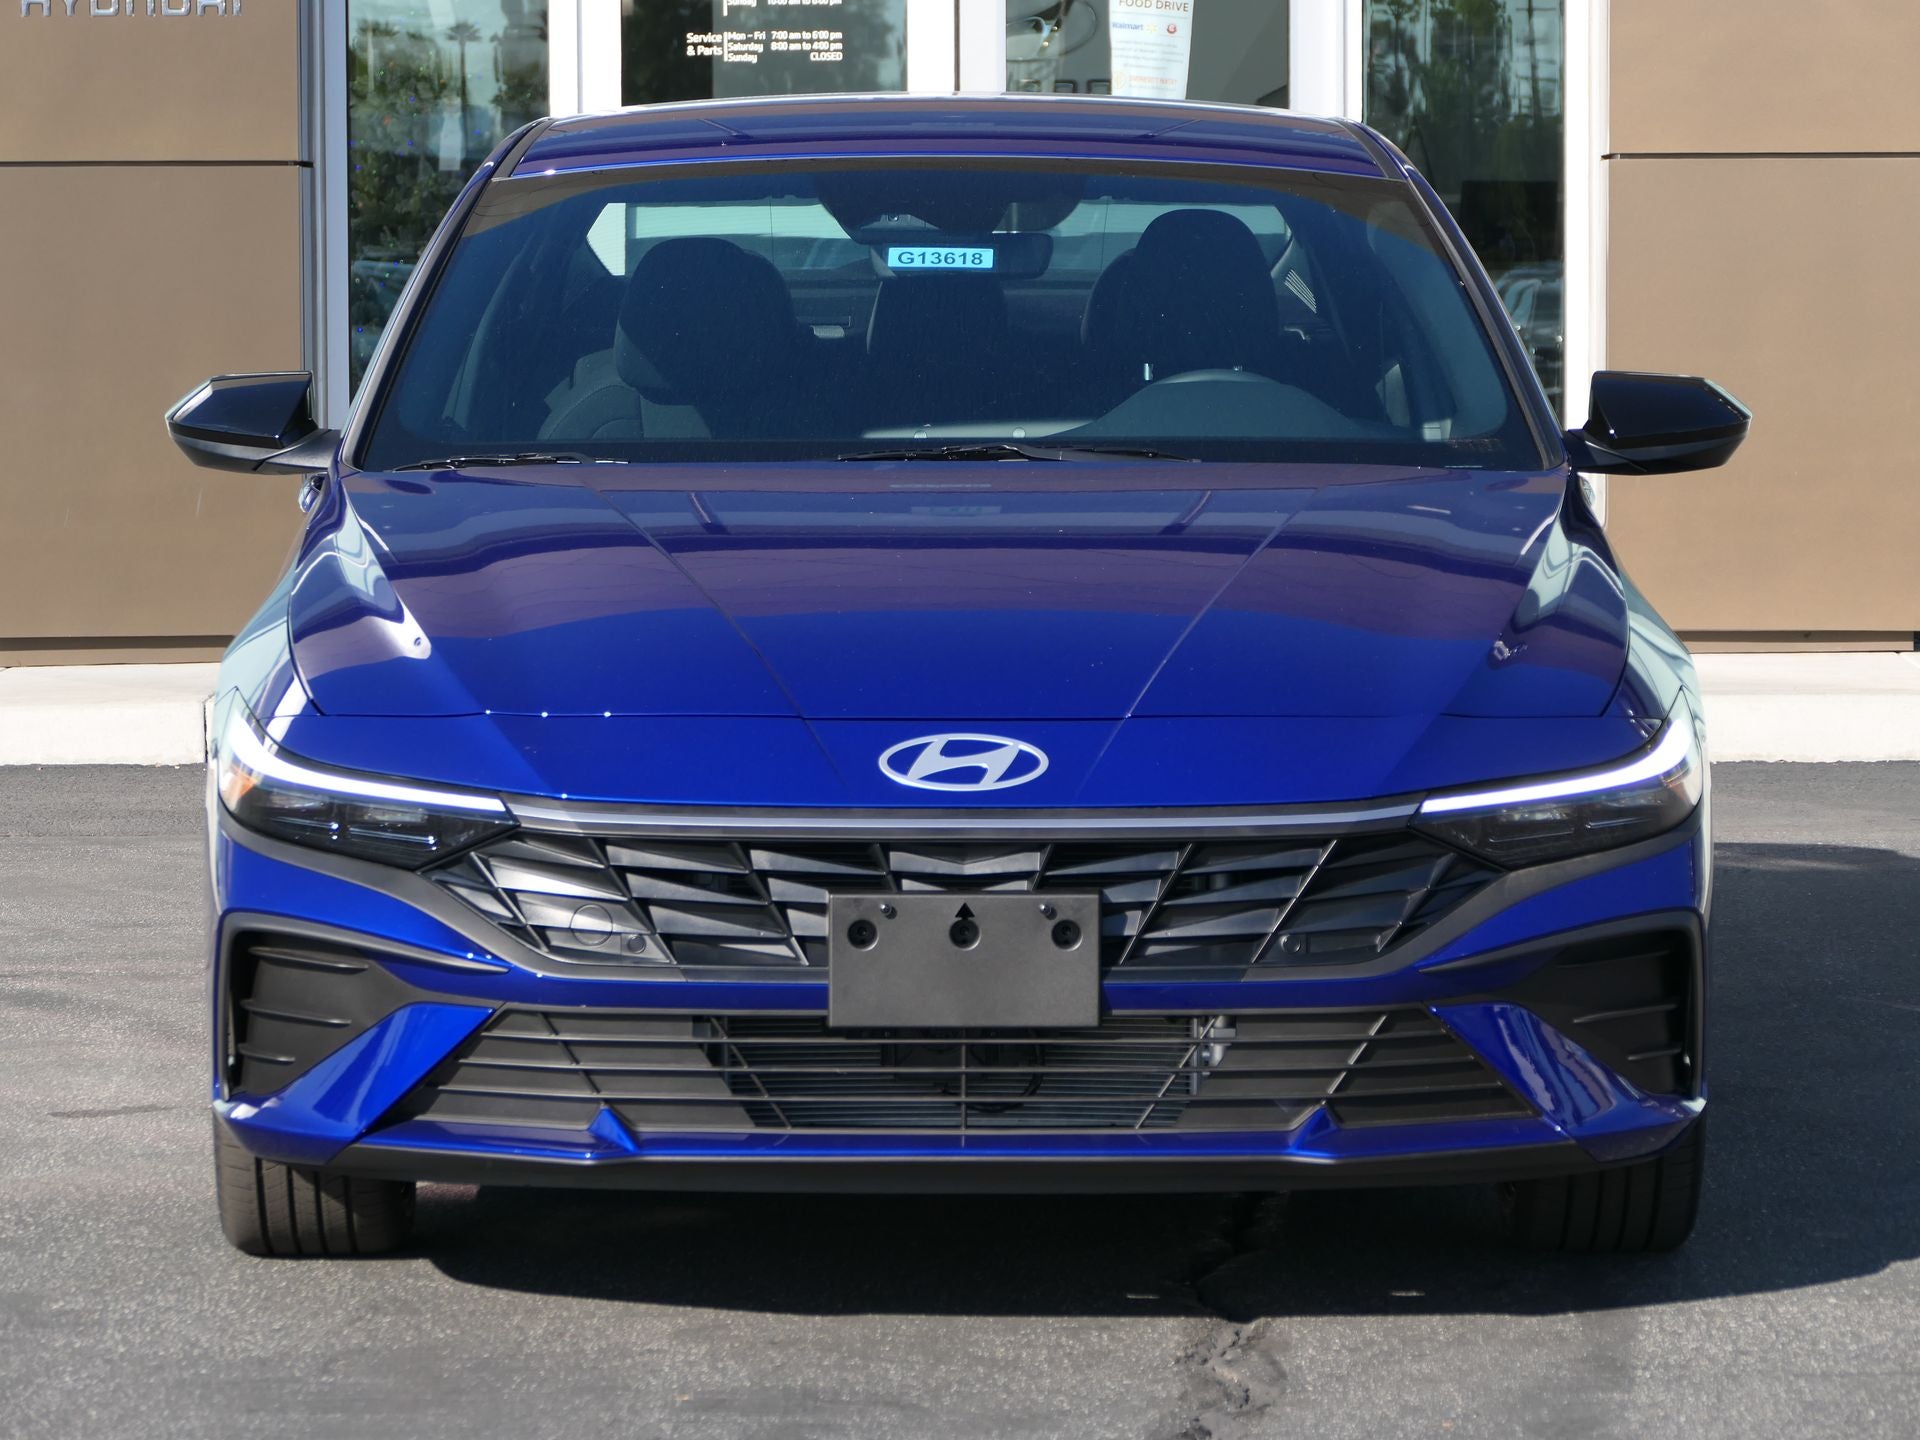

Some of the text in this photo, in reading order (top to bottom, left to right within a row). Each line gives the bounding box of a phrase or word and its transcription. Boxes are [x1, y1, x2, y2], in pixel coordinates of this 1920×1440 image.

[1119, 0, 1189, 12] FOOD DRIVE
[686, 32, 722, 43] Service
[728, 32, 746, 40] Mon
[754, 31, 765, 40] Fri
[771, 31, 788, 40] 7:00
[789, 32, 801, 40] am
[802, 31, 811, 40] to
[830, 32, 843, 41] pm
[686, 45, 722, 56] & Parts
[728, 41, 843, 52] Saturday 8:00 am to 4:00 pm
[728, 52, 843, 63] Sunday CLOSED
[897, 251, 983, 266] G13618
